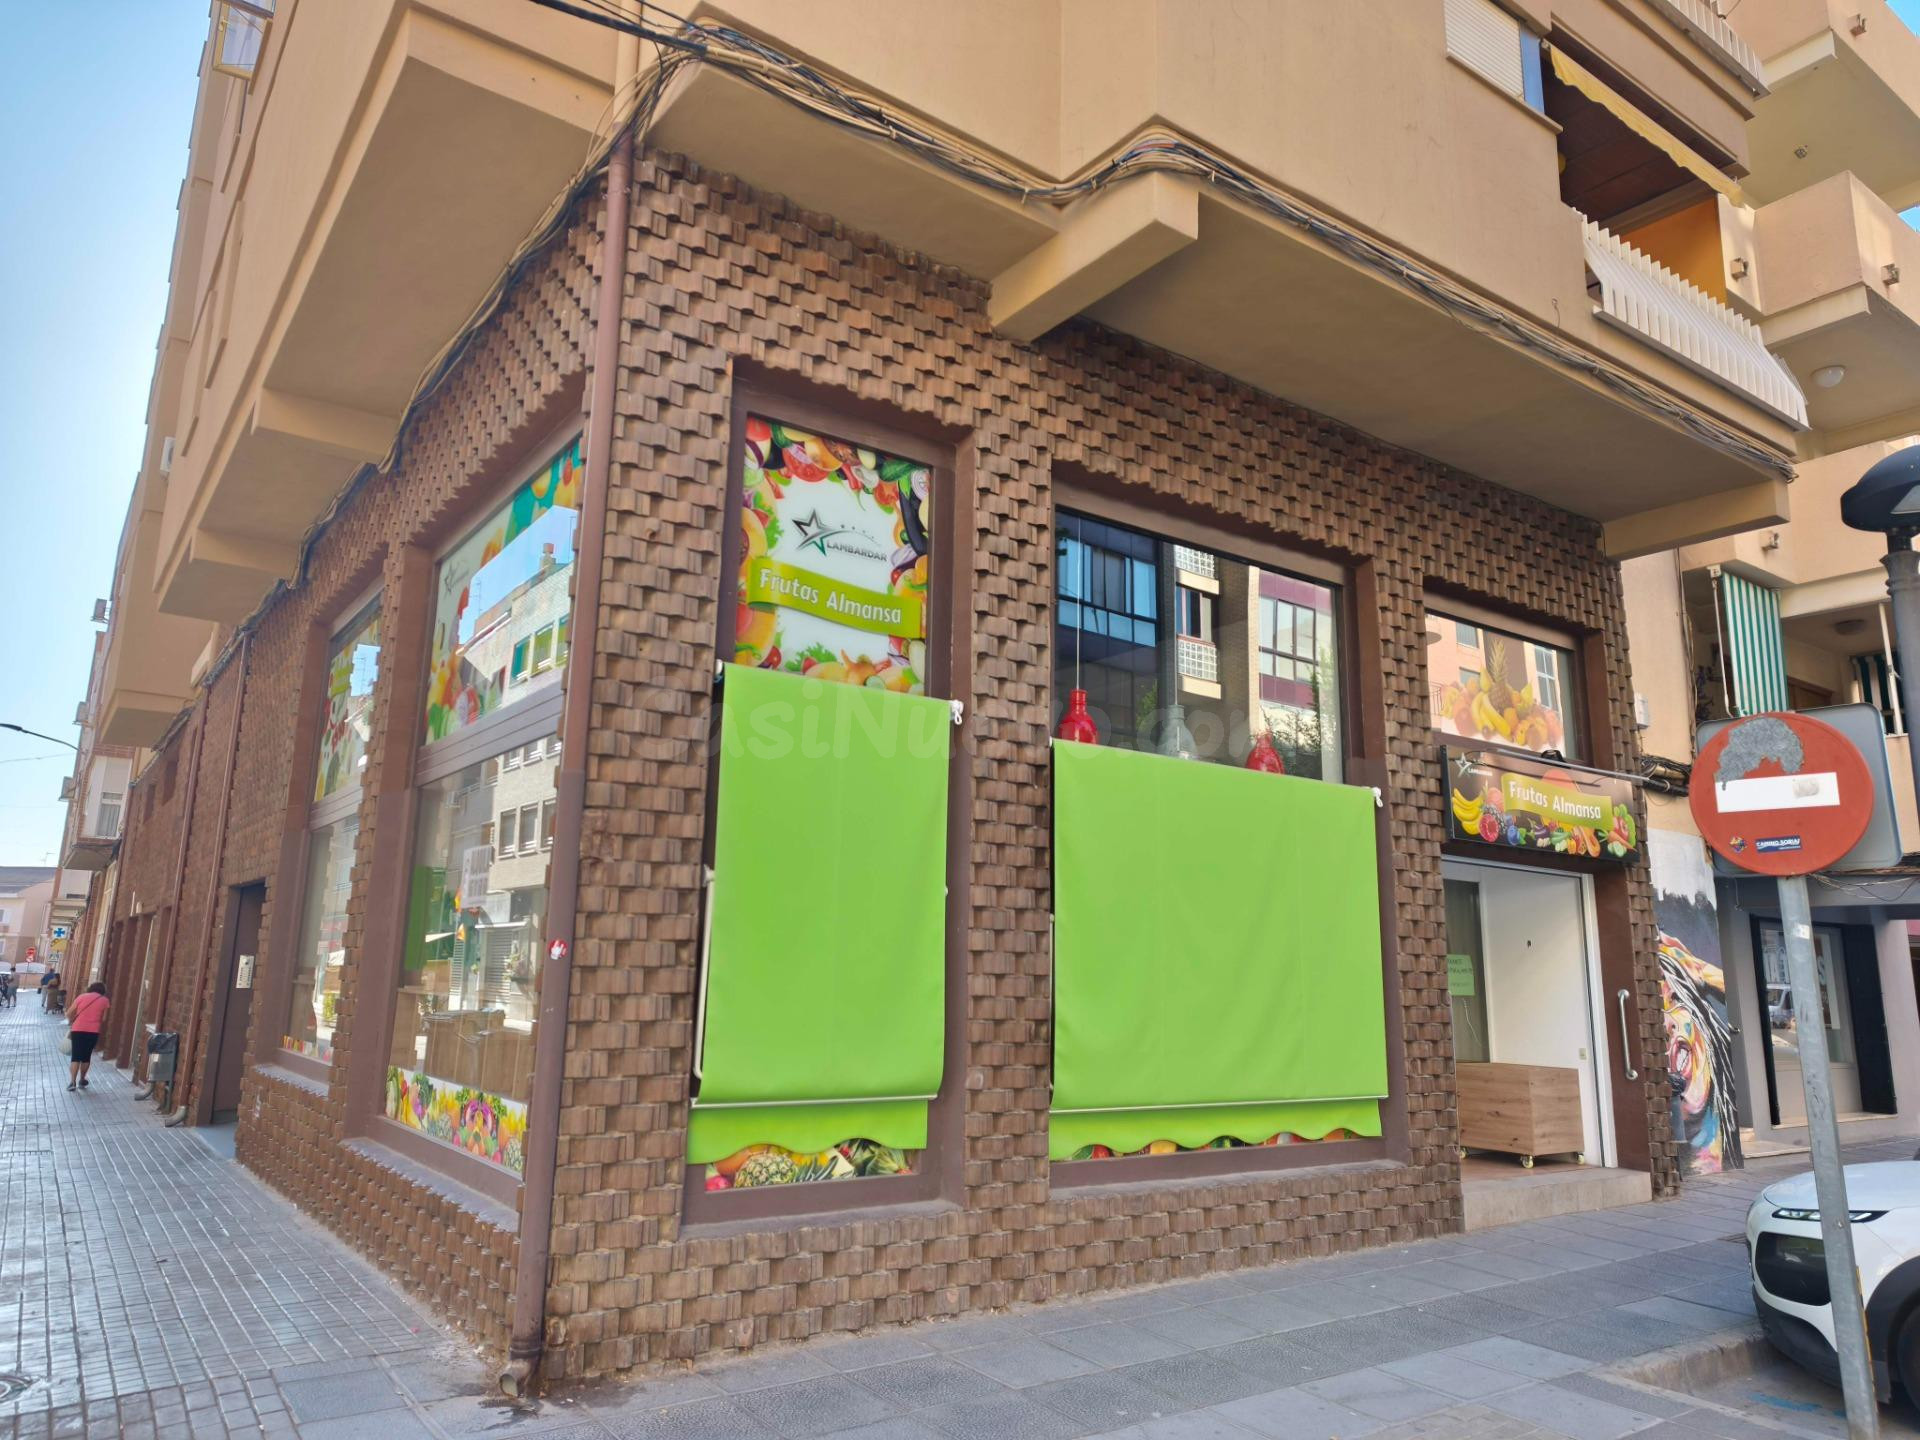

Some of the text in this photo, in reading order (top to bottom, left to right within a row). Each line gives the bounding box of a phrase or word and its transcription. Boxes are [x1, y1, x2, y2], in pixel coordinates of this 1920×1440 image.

[760, 568, 901, 623] Frutas Almansa
[1509, 780, 1601, 819] Frutas Almansa
